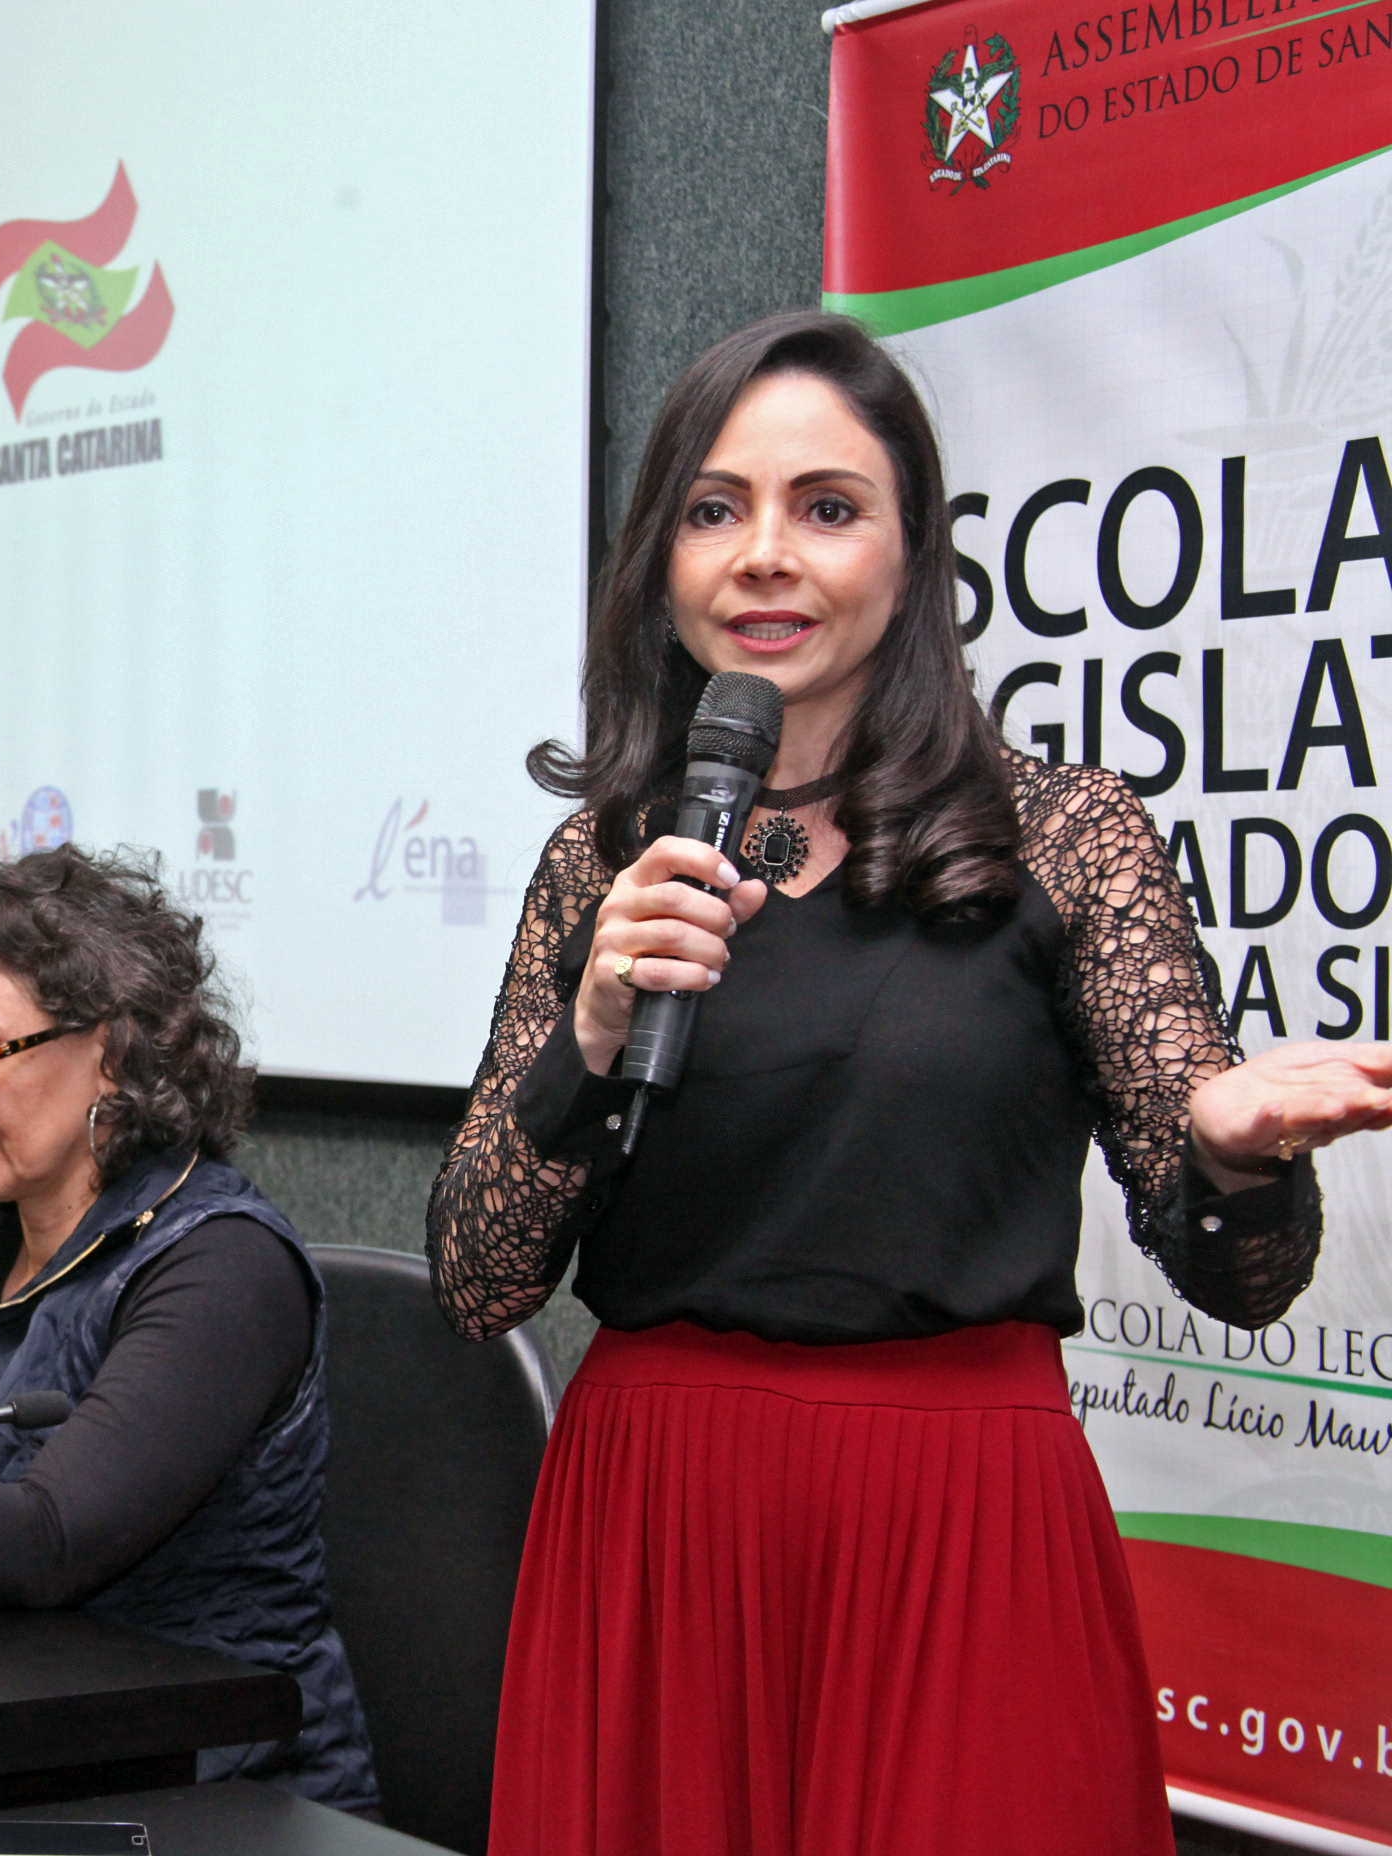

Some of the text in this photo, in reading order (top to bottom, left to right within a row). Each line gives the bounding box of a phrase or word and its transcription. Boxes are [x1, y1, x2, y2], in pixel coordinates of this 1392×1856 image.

[1040, 0, 1320, 78] ASSEMBL
[1038, 96, 1090, 139] DO
[1103, 57, 1240, 123] ESTADO
[1255, 38, 1303, 84] DE
[56, 417, 164, 476] CATARINA
[968, 636, 1392, 797] GISLA
[1072, 1296, 1204, 1356] COLA
[1223, 1320, 1296, 1367] DO
[1203, 1381, 1284, 1439] Lício
